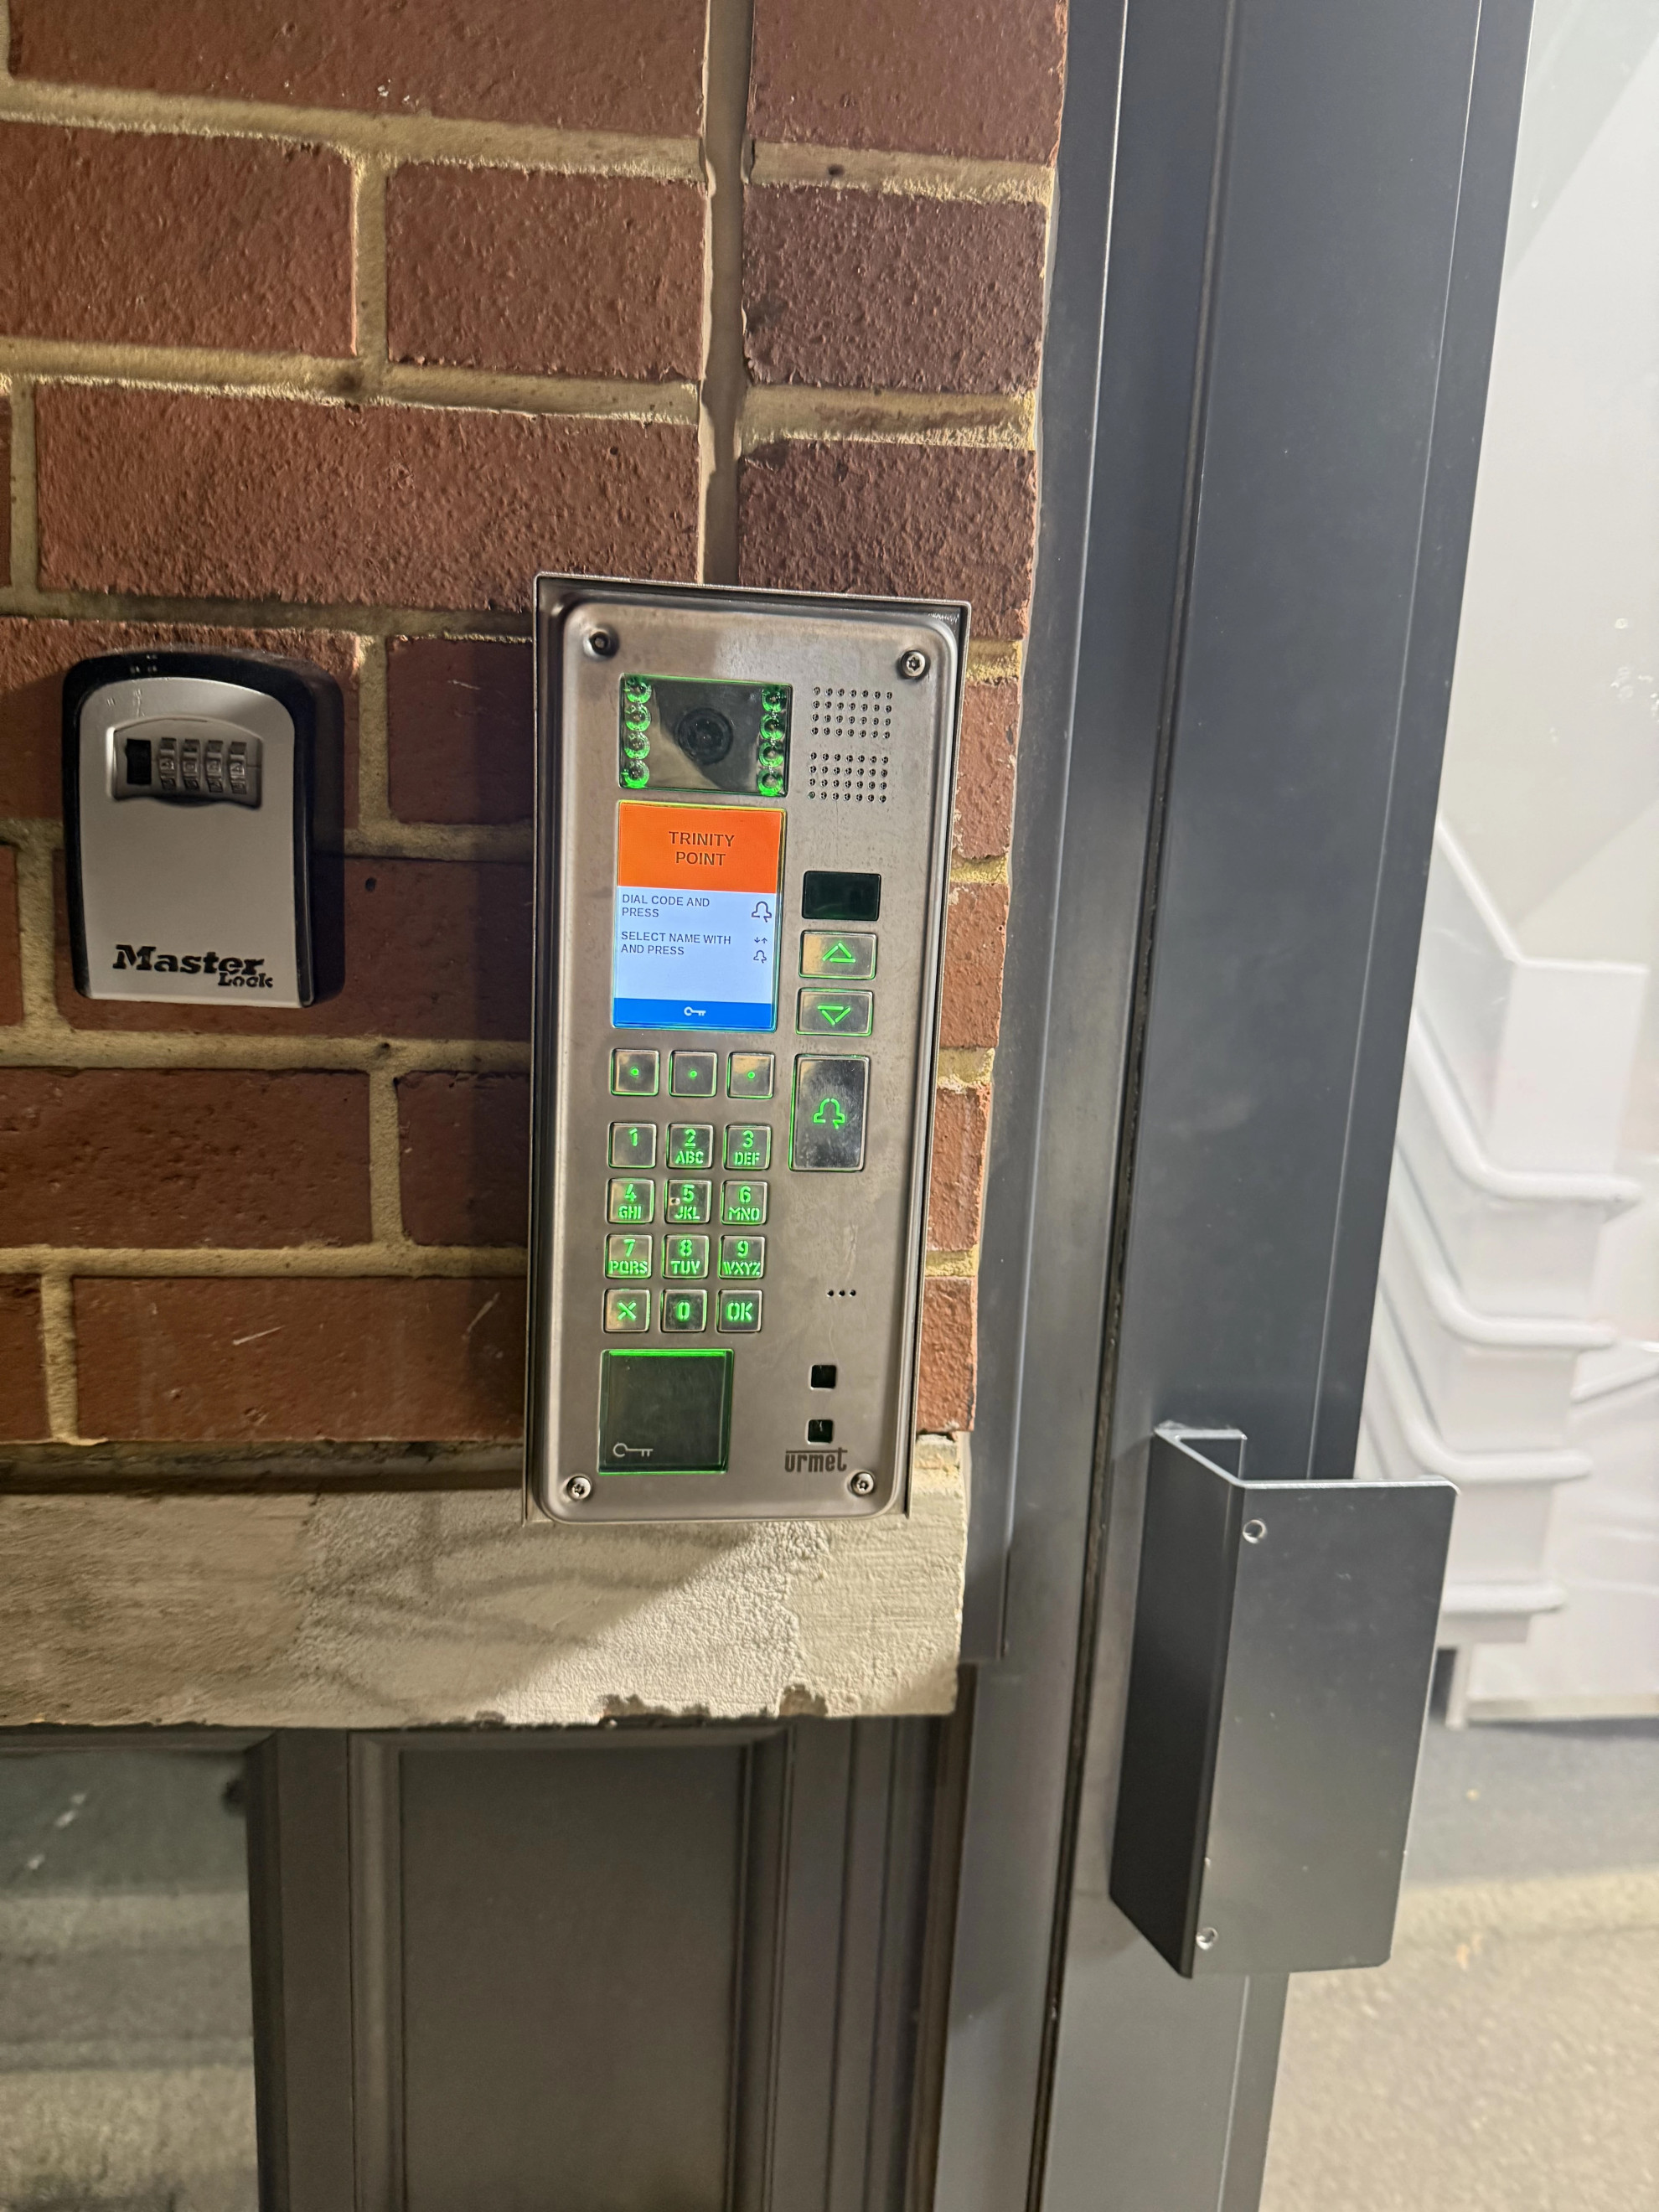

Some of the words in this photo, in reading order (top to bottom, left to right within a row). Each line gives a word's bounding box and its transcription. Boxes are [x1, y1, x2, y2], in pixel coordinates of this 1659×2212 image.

[669, 830, 735, 847] TRINITY
[675, 851, 726, 866] POINT
[622, 894, 649, 905] DIAL
[651, 895, 684, 907] CODE
[686, 897, 711, 907] AND
[622, 907, 659, 917] PRESS
[621, 931, 666, 943] SELECT
[669, 933, 700, 943] NAME
[703, 934, 731, 945] WITH
[621, 943, 645, 954] AND
[648, 945, 685, 955] PRESS
[112, 943, 265, 975] Master
[218, 972, 273, 989] Lock
[629, 1128, 638, 1147] 1
[685, 1129, 696, 1147] 2
[742, 1129, 754, 1148] 3
[674, 1150, 705, 1165] ABC
[734, 1151, 761, 1165] DEF
[624, 1183, 637, 1202] 4
[683, 1184, 695, 1202] 5
[739, 1186, 752, 1203] 6
[618, 1206, 642, 1220] GHI
[674, 1207, 700, 1220] JKL
[728, 1207, 760, 1221] MNO
[623, 1238, 636, 1257] 7
[680, 1239, 692, 1257] 8
[737, 1240, 749, 1258] 9
[608, 1260, 649, 1274] PQRS
[670, 1260, 700, 1274] TUV
[723, 1261, 761, 1276] WXYZ
[727, 1302, 753, 1321] OK
[784, 1447, 848, 1473] urmet
